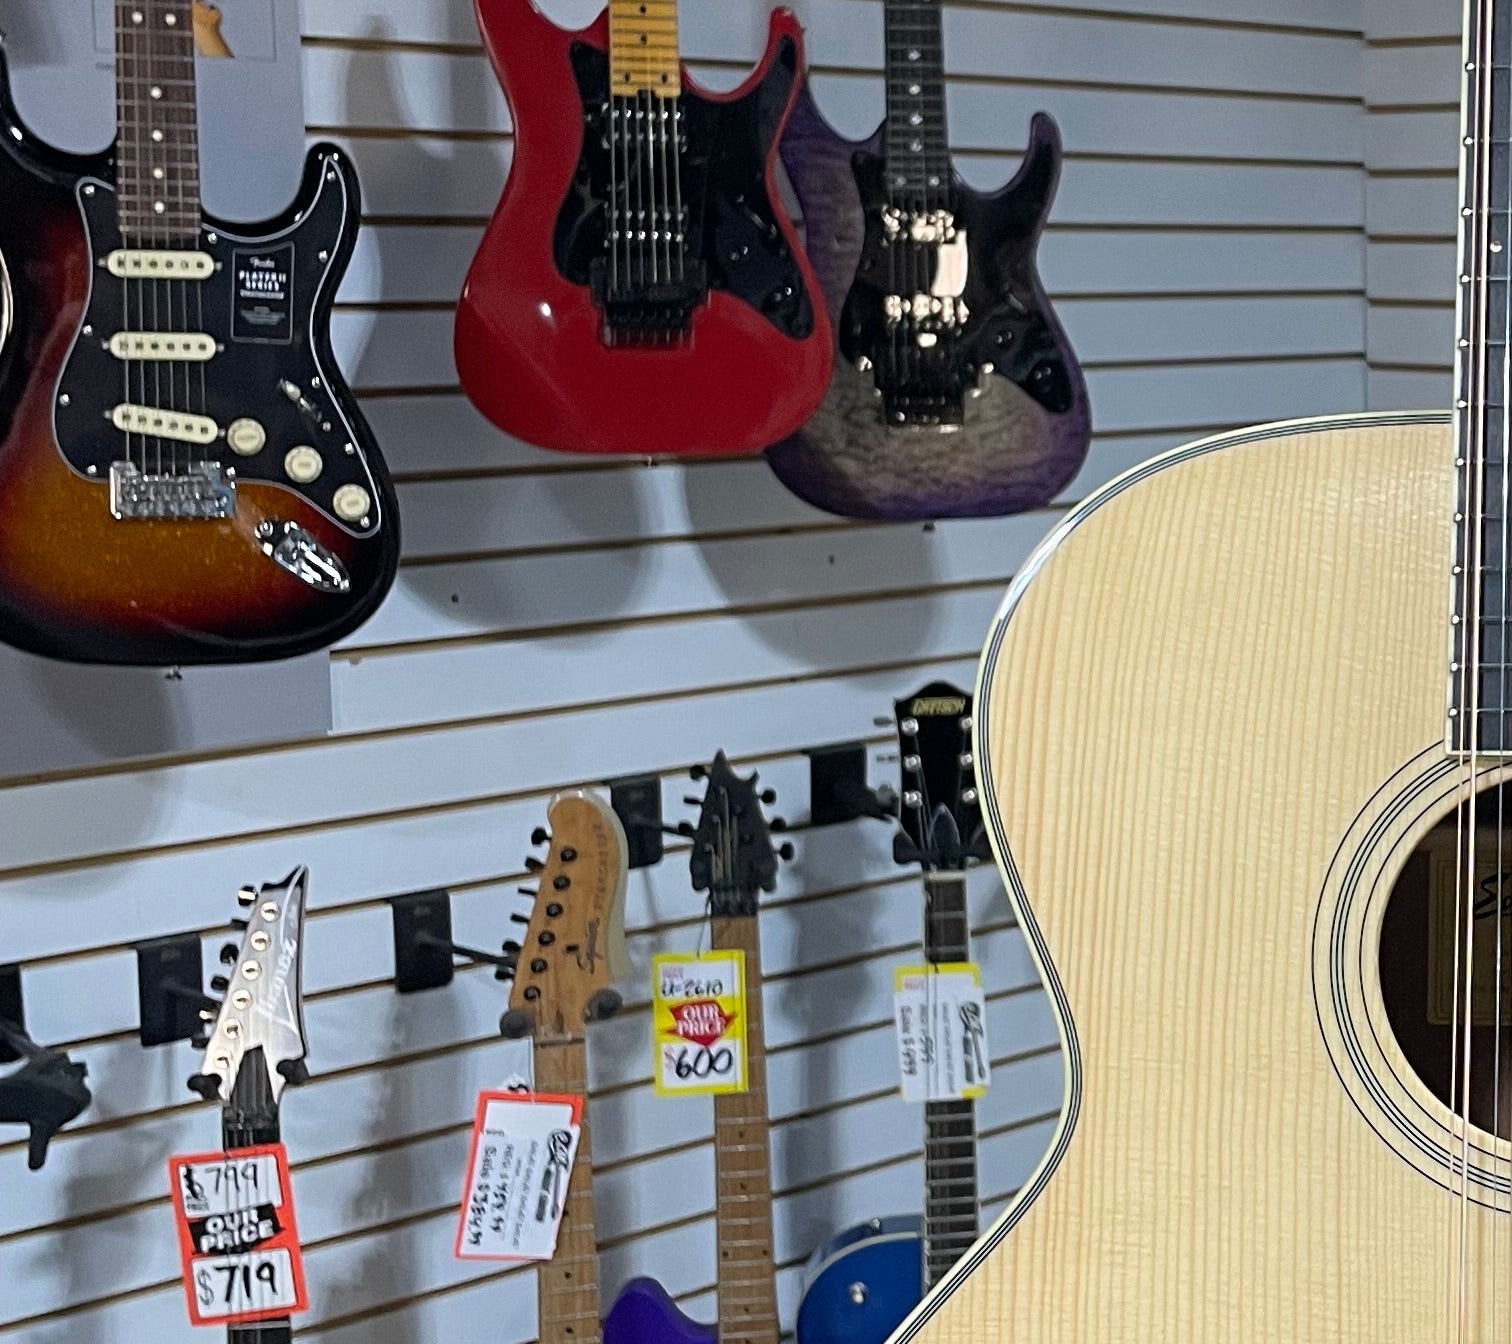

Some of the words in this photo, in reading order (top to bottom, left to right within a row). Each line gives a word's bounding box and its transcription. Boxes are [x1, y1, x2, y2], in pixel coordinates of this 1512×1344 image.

[682, 1004, 720, 1021] OUR
[677, 1017, 726, 1037] PRICE
[205, 1209, 259, 1234] OUR
[199, 1220, 275, 1254] PRICE
[196, 1261, 279, 1306] $719
